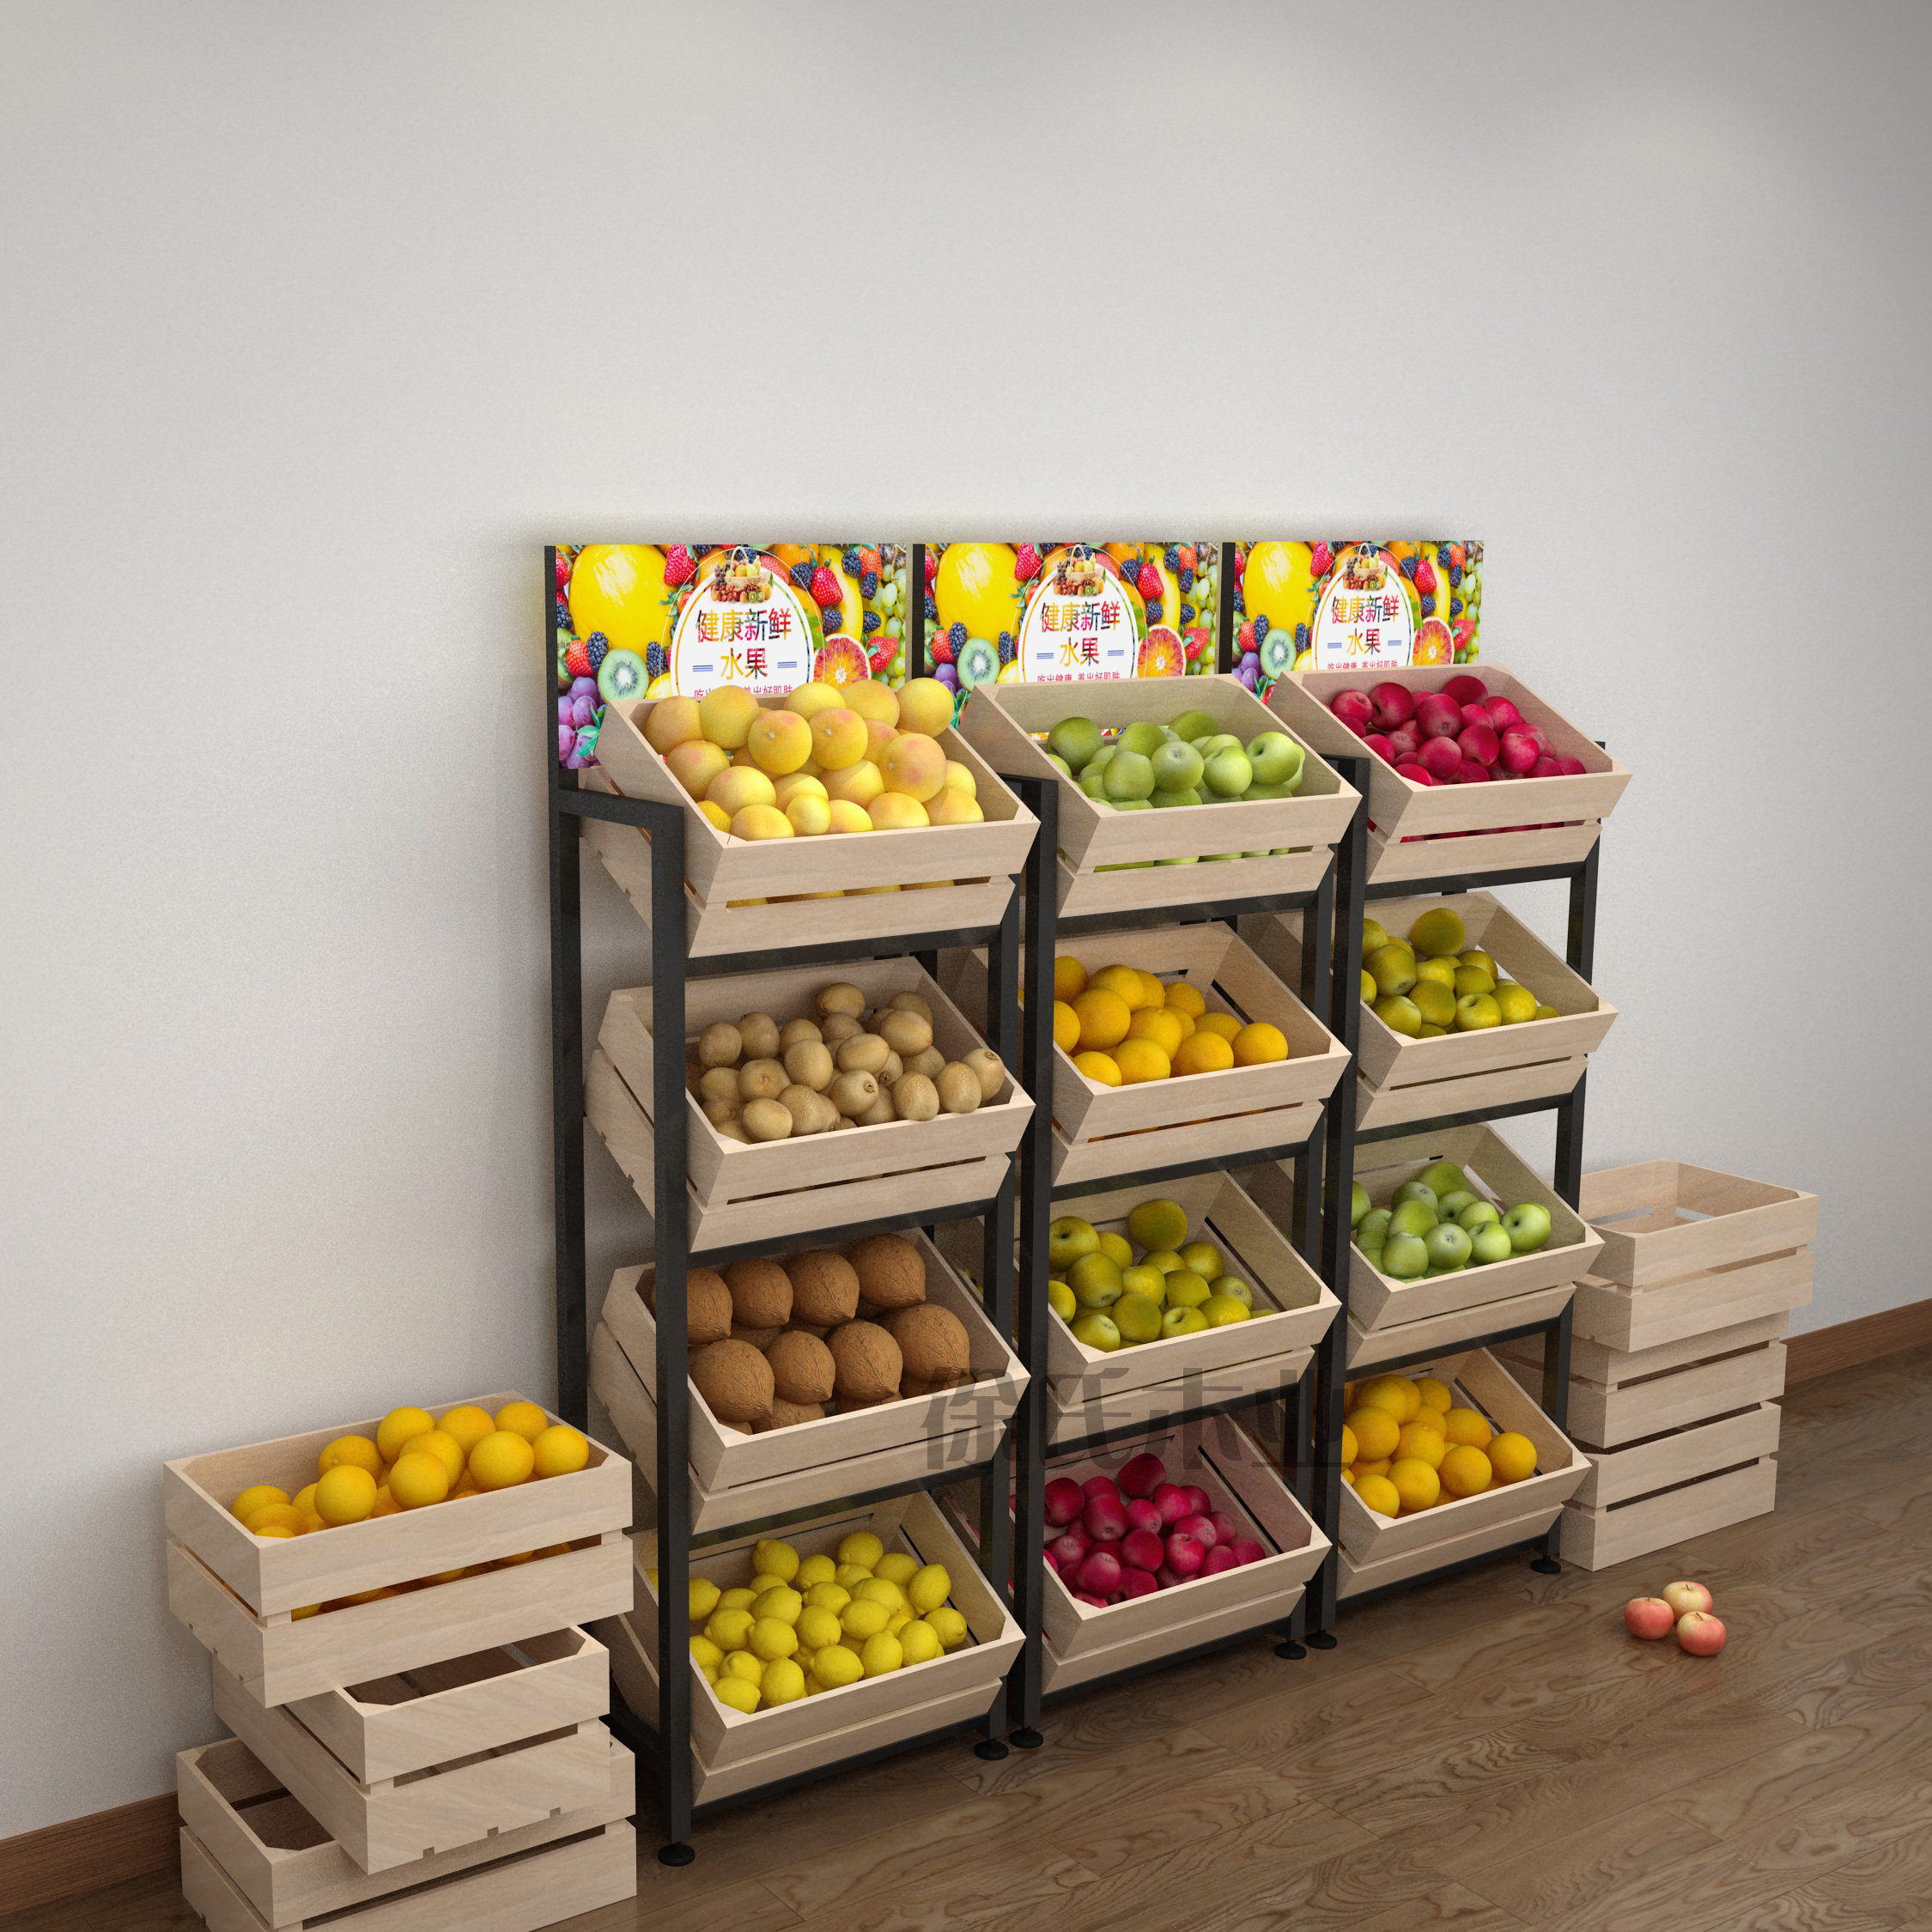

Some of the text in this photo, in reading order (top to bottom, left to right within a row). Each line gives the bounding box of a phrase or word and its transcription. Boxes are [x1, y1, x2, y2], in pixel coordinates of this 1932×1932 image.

[1041, 600, 1121, 634] 健康新鲜
[1332, 595, 1400, 624] 健康新鲜
[696, 608, 792, 643] 健康新鲜
[1060, 637, 1100, 666] 水果
[1347, 629, 1381, 655] 水果
[720, 647, 768, 680] 水果
